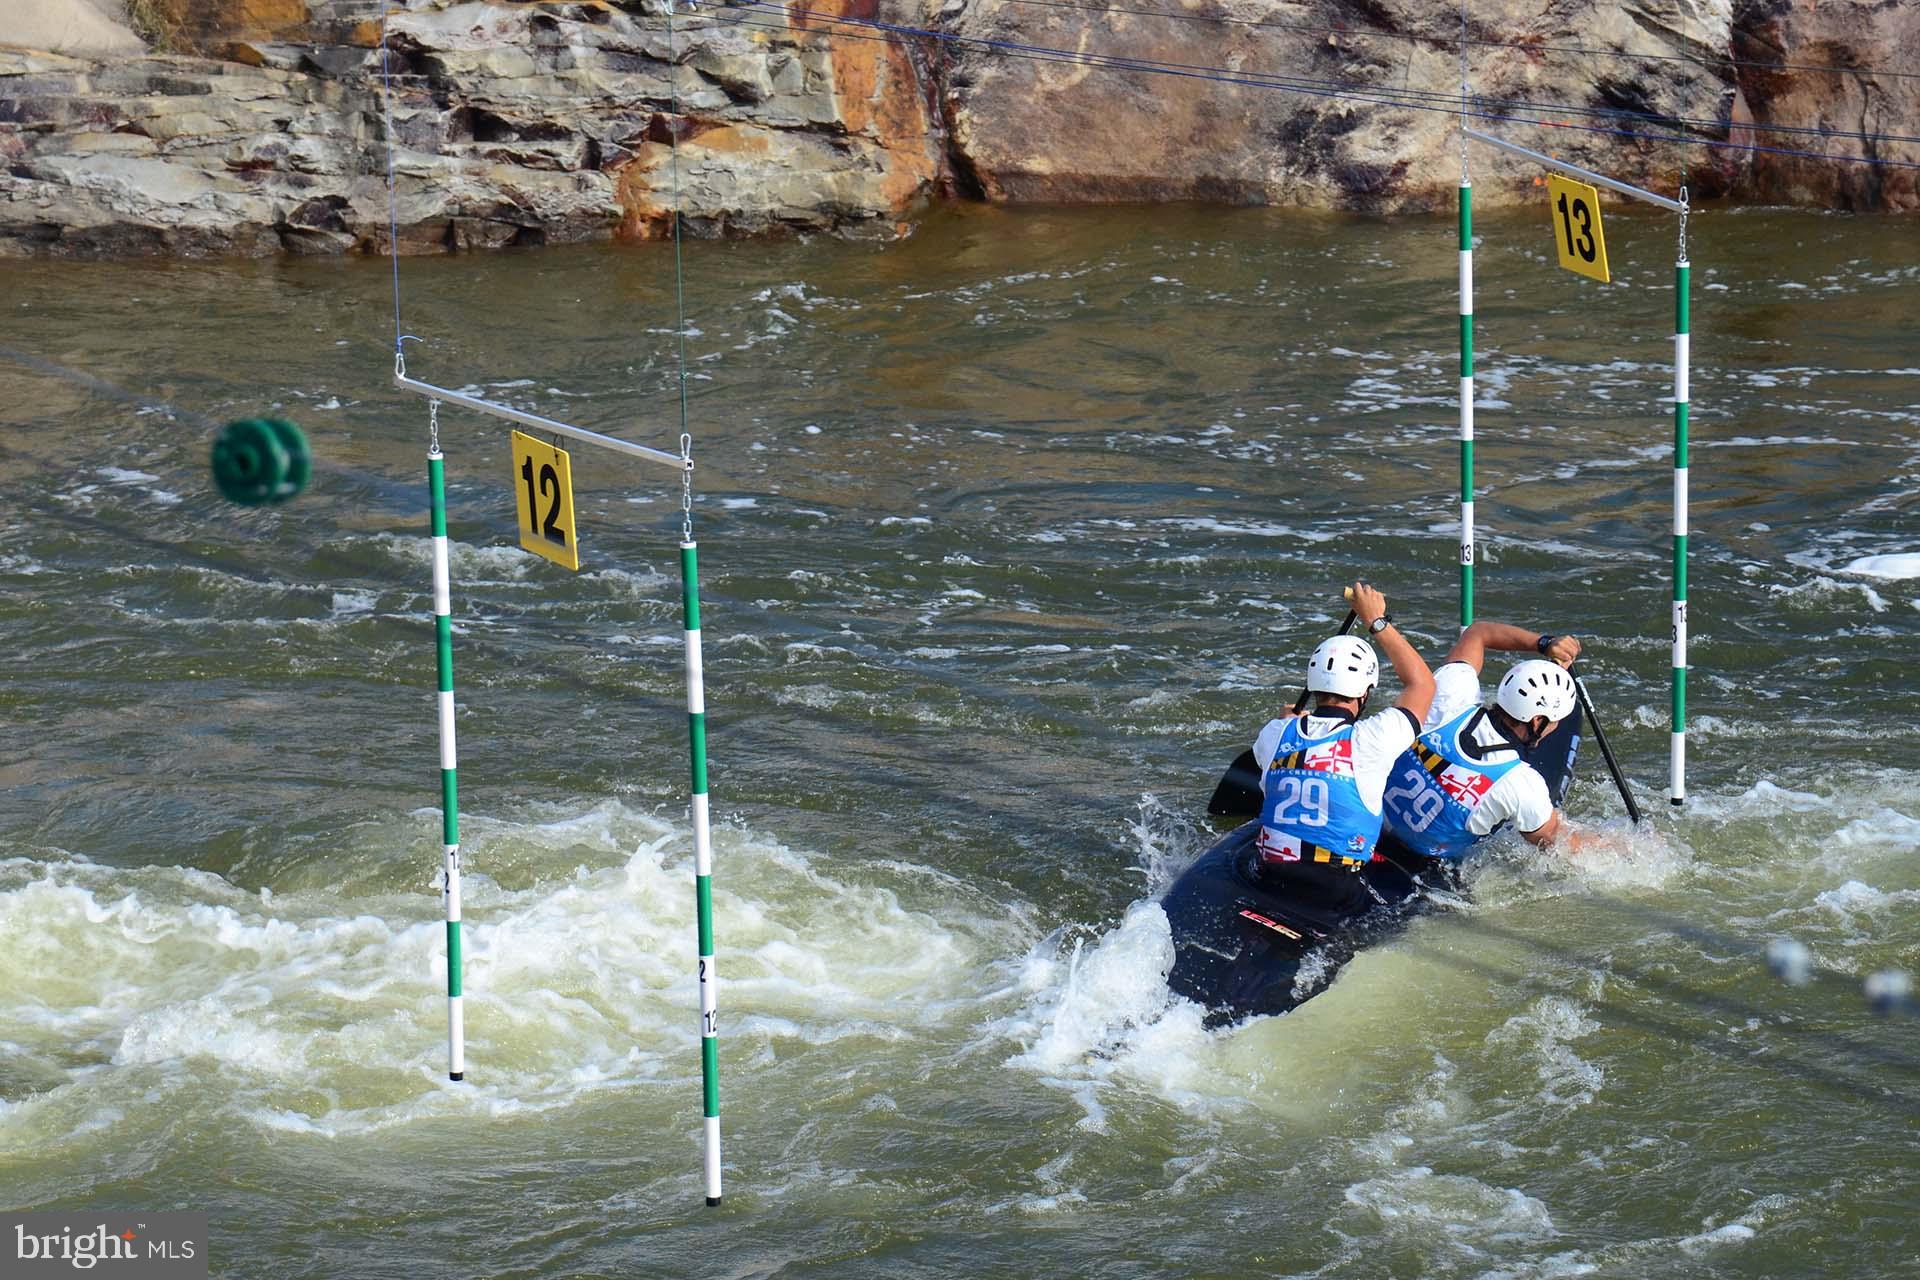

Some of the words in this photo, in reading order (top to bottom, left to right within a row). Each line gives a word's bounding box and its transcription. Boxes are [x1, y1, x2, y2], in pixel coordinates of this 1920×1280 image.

[1557, 192, 1596, 263] 13
[521, 455, 566, 547] 12
[1460, 544, 1471, 562] 13
[1289, 769, 1320, 777] CREEK
[1273, 776, 1329, 827] 29
[1383, 769, 1444, 832] 29
[698, 960, 706, 983] 2
[704, 1010, 717, 1033] 12
